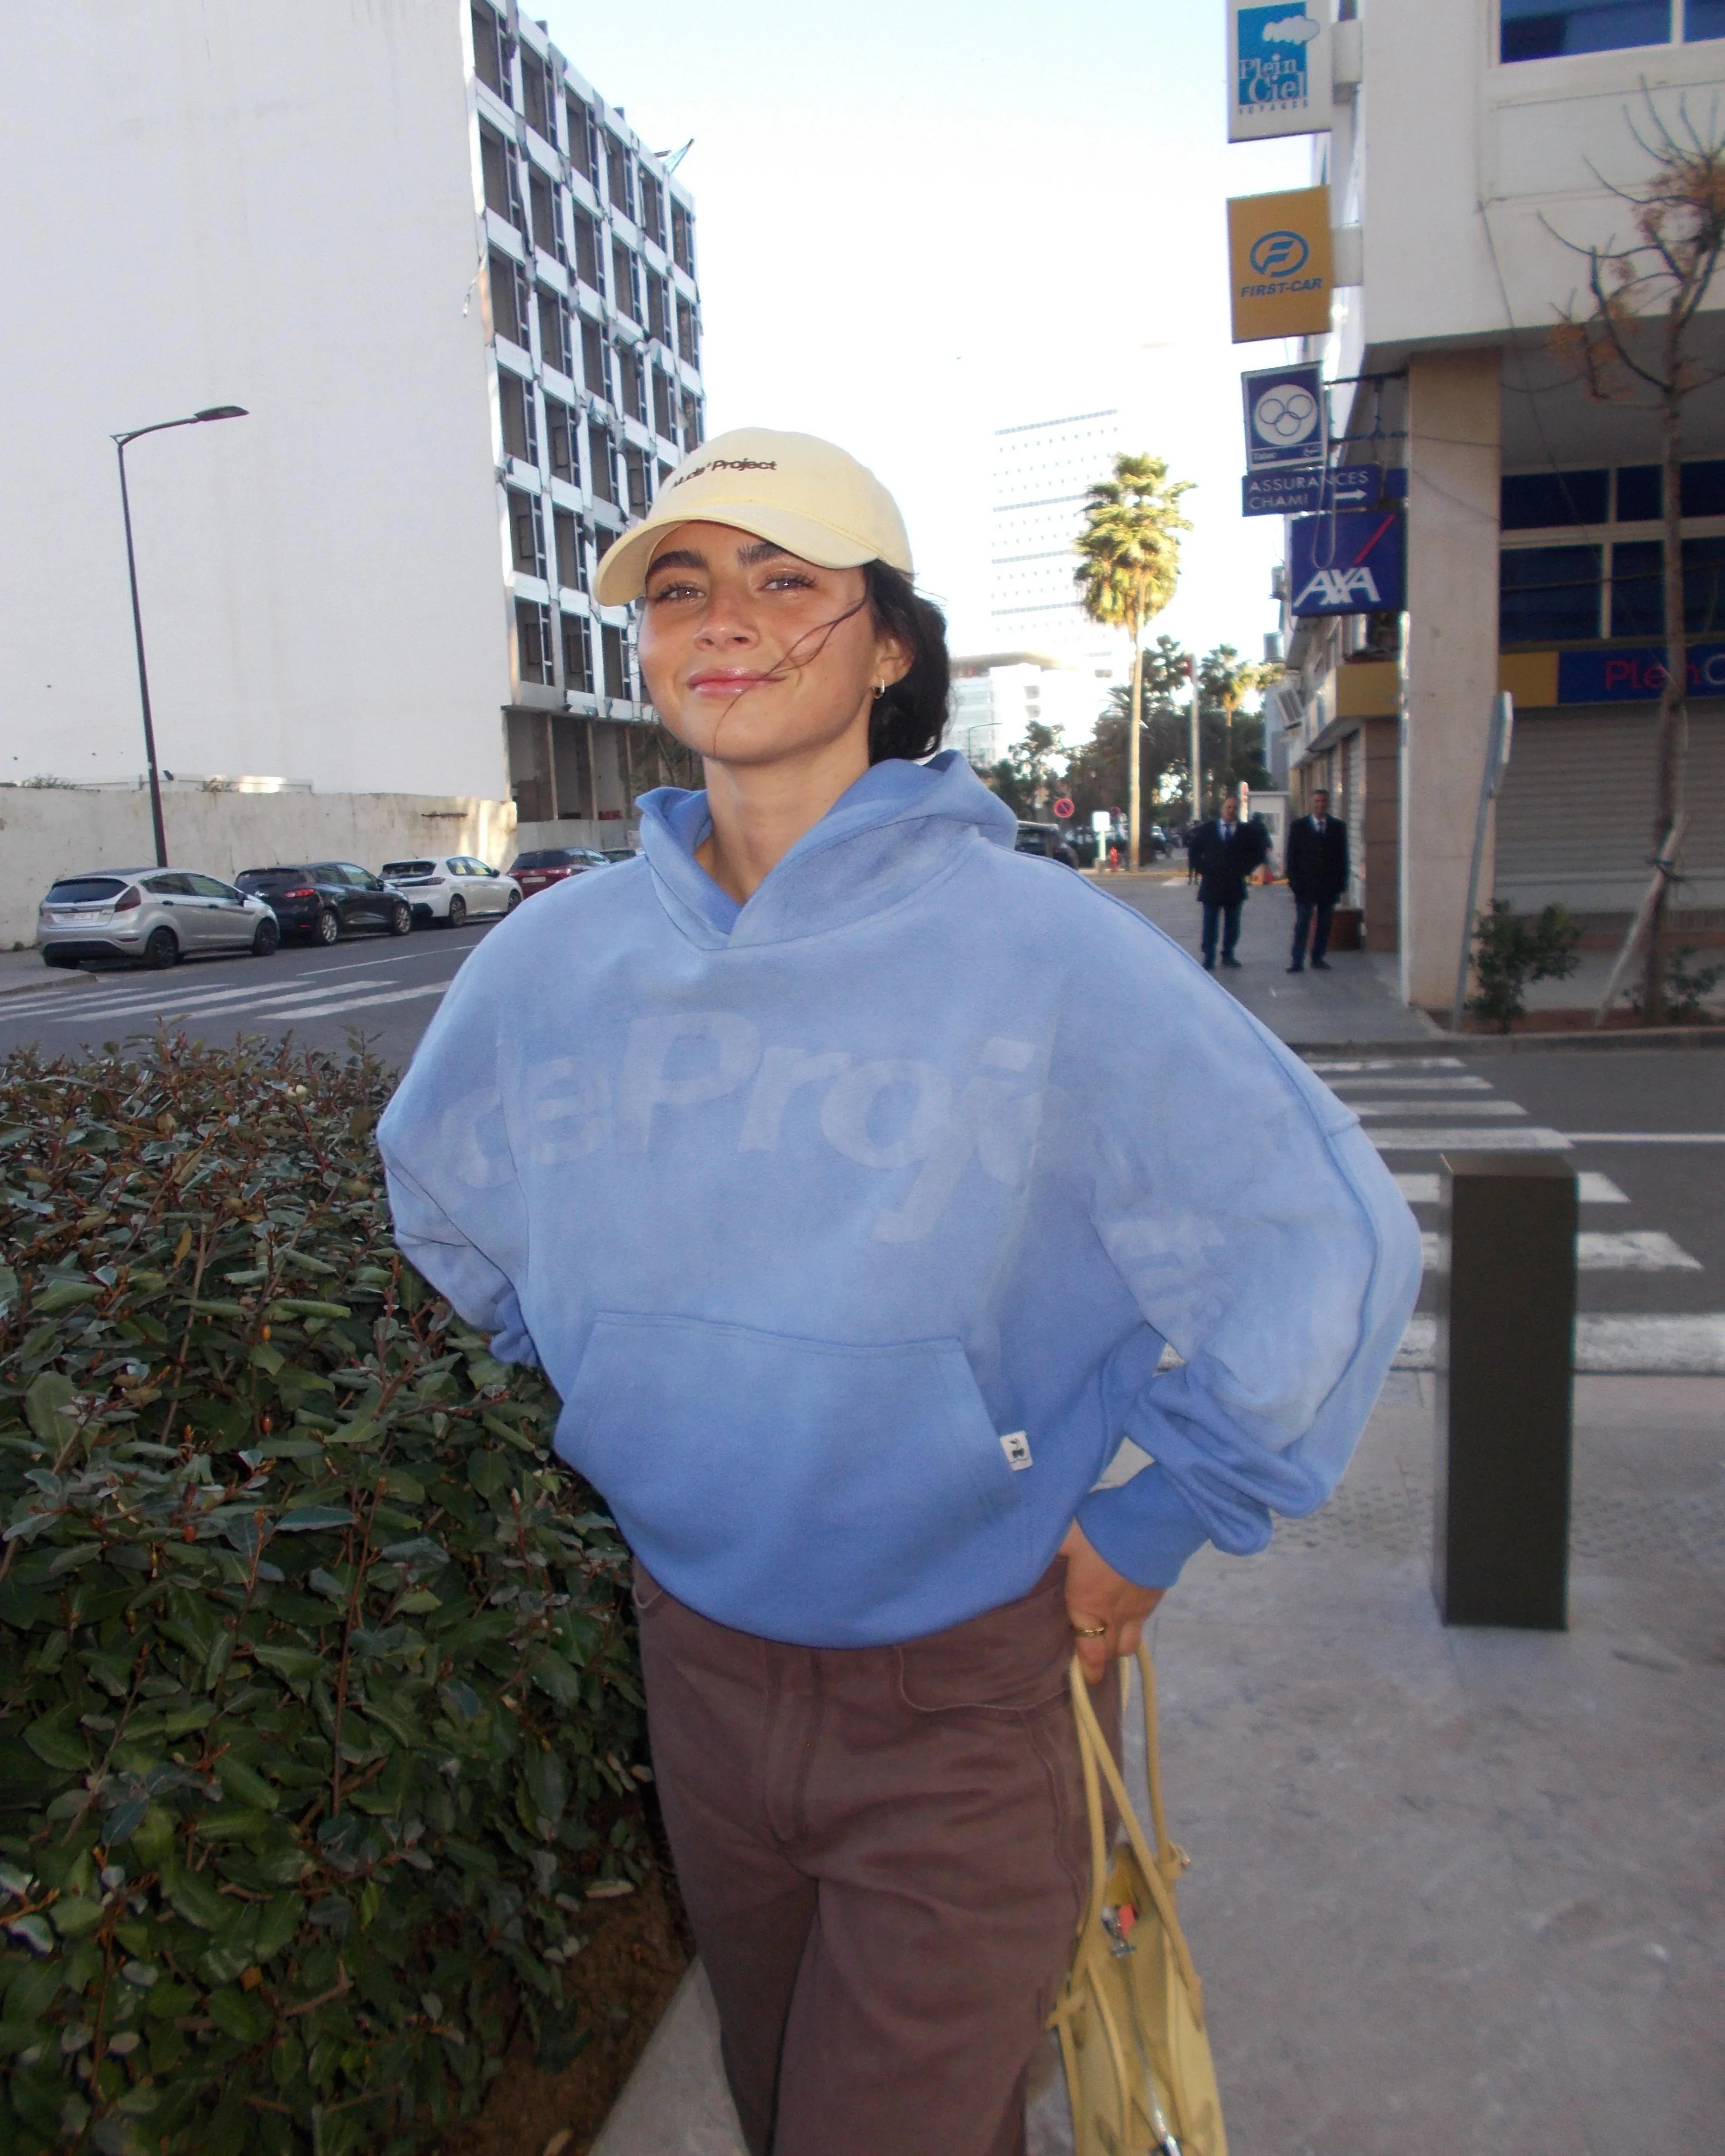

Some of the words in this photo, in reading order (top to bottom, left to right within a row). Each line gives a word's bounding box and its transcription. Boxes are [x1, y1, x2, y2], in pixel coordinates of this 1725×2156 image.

[1239, 54, 1297, 79] Plein
[1249, 71, 1305, 103] Ciel
[1241, 278, 1322, 298] FIRST-CAR
[712, 458, 777, 471] Project
[1249, 471, 1368, 492] ASSURANCES
[1294, 567, 1381, 607] AXA
[1604, 658, 1703, 690] Plen
